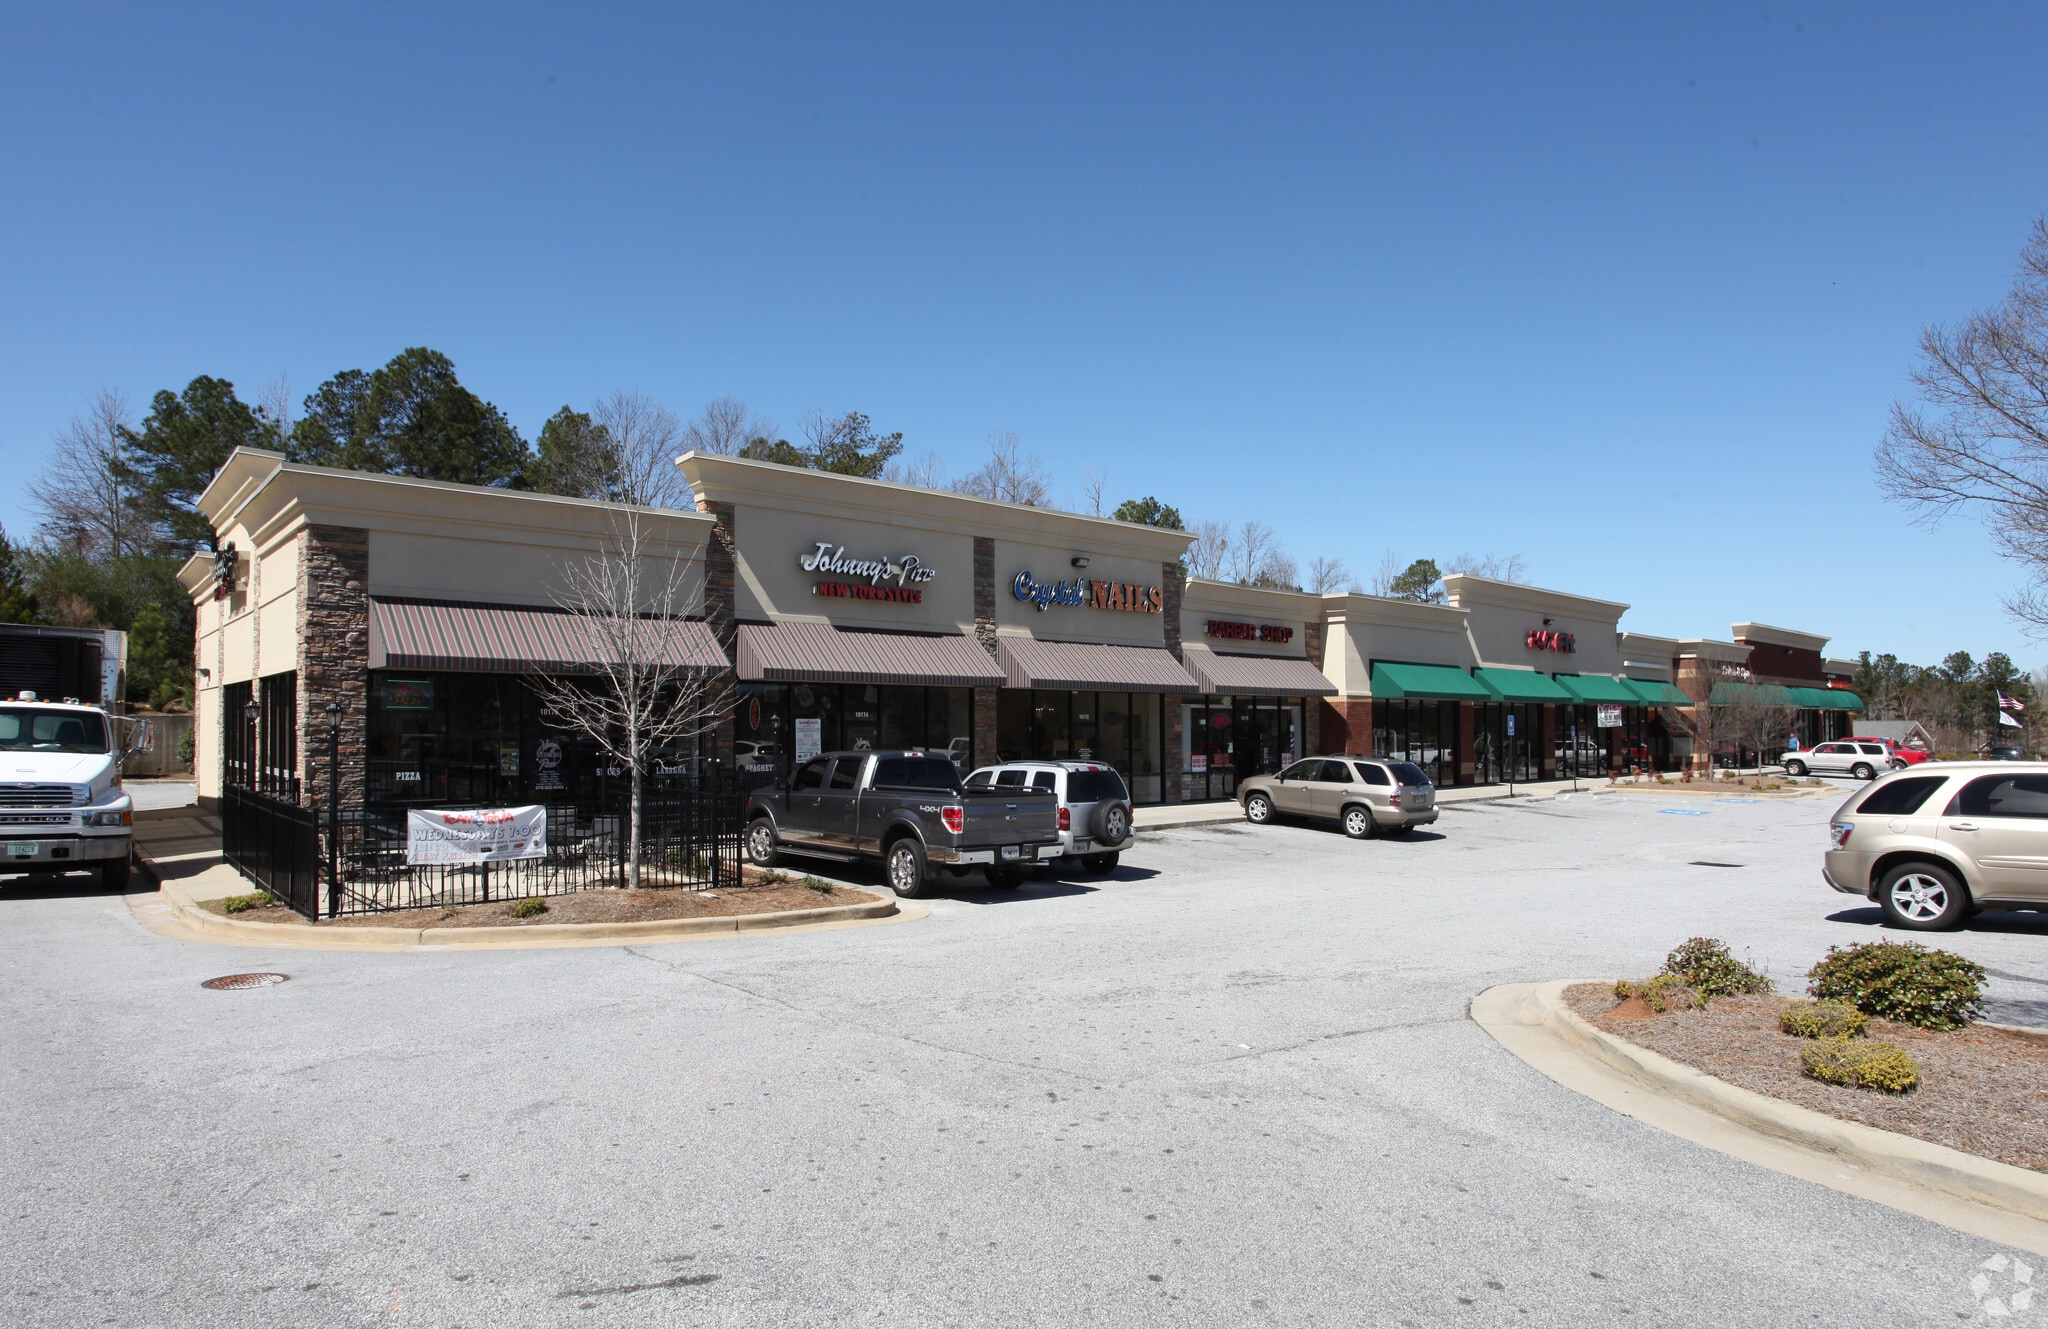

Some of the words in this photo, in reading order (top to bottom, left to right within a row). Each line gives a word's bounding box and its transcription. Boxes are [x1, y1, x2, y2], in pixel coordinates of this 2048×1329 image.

[803, 542, 893, 586] Johnny's
[899, 554, 936, 587] Pizza
[819, 582, 849, 598] NEW
[851, 585, 885, 601] YORK
[886, 587, 922, 604] STYLE
[1014, 569, 1084, 613] Crystal
[1091, 579, 1163, 614] NAILS
[1208, 620, 1257, 640] BARBER
[1260, 624, 1294, 643] SHOP
[395, 771, 421, 782] PIZZA
[596, 767, 621, 776] SCES
[656, 767, 687, 775] LASAGNA
[746, 764, 775, 772] SPAGHET
[414, 824, 505, 841] WEDNESDAYS
